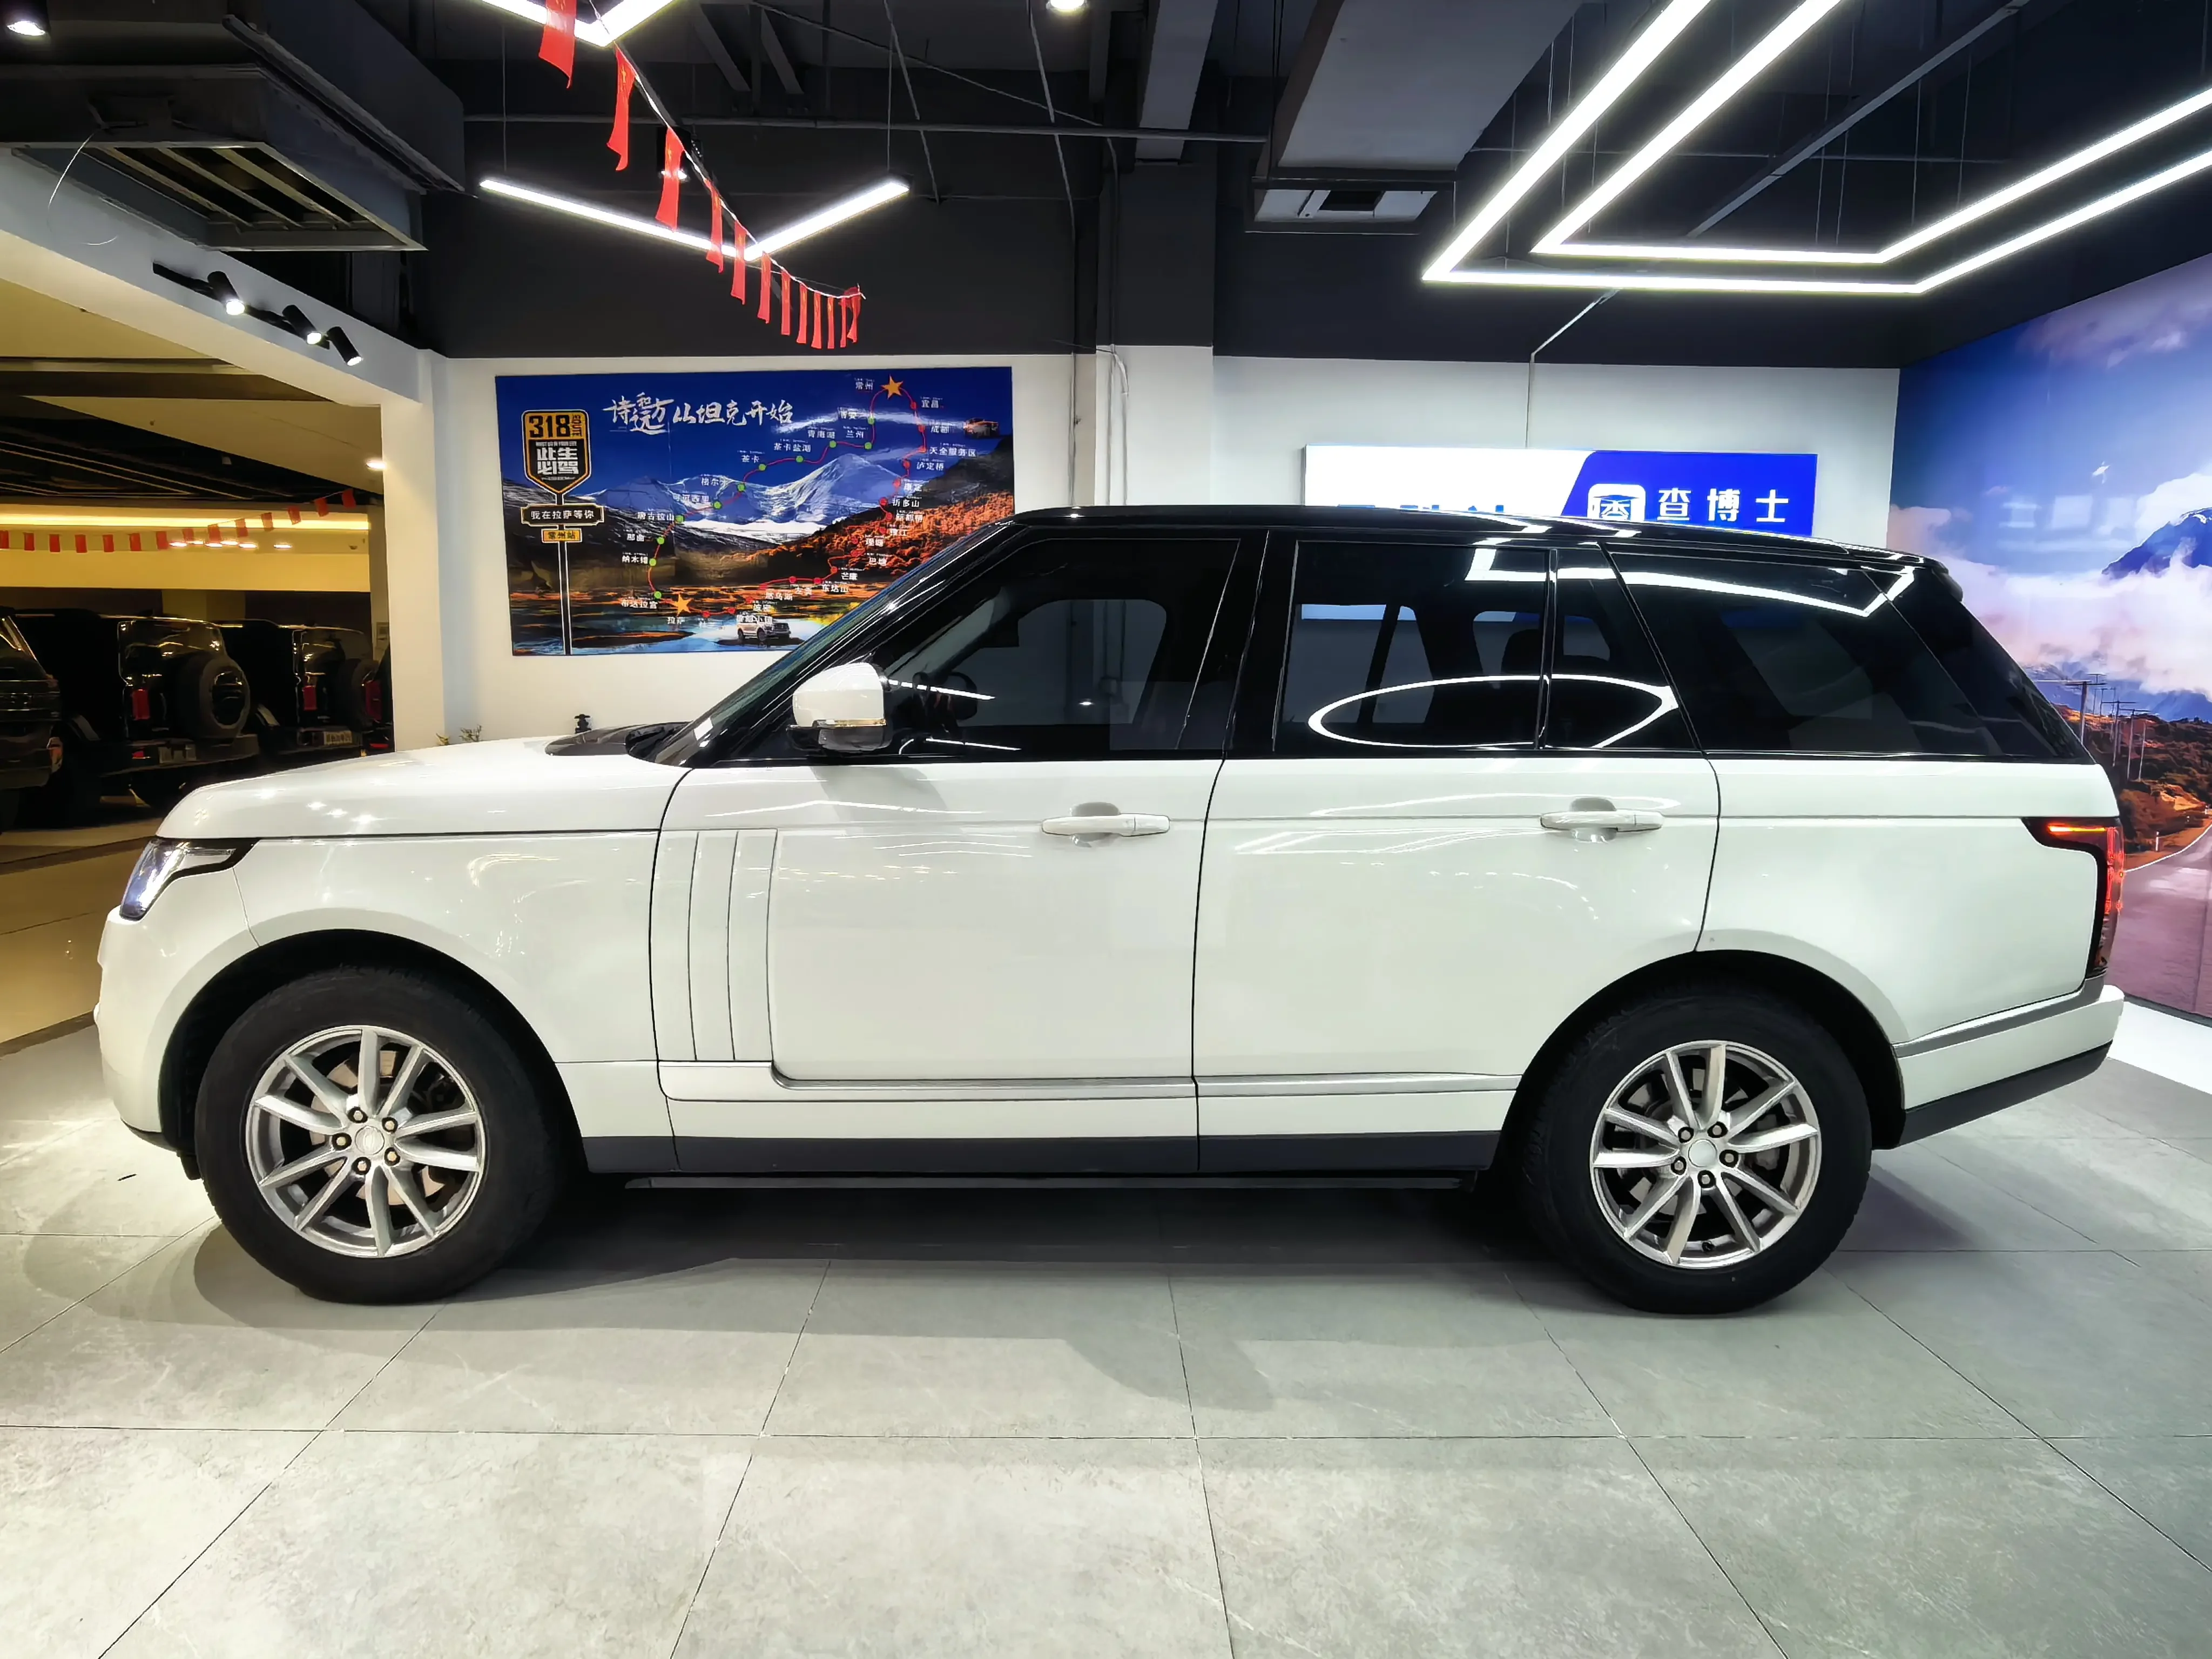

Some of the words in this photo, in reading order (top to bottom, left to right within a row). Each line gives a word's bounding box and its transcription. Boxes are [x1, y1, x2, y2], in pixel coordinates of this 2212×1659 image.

[529, 415, 570, 438] 318
[537, 447, 578, 460] 此生
[537, 461, 579, 475] 必驾
[1657, 487, 1789, 523] 查博士
[530, 510, 594, 520] 我在拉萨等你
